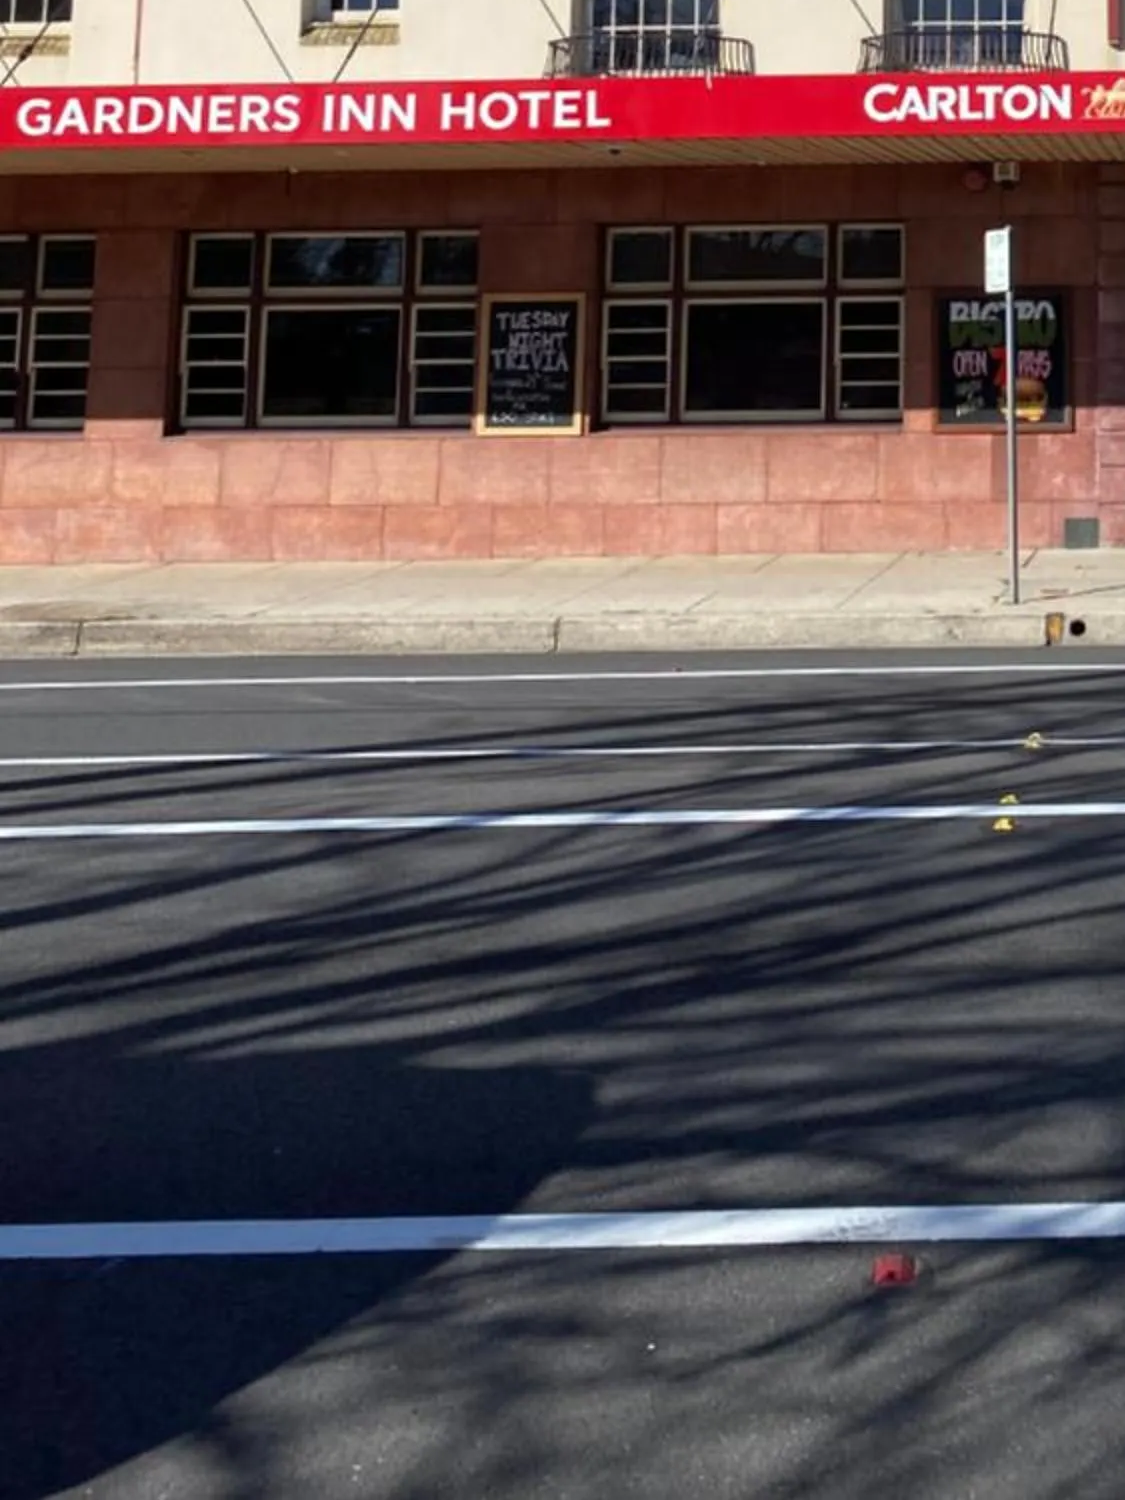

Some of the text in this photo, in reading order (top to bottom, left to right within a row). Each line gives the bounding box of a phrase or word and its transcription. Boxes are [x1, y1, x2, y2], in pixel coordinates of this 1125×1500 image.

[15, 89, 611, 137] GARDNERS INN HOTEL
[862, 83, 1072, 122] CARLTON
[496, 311, 571, 330] TUESDAY
[949, 300, 1057, 350] BISRO
[508, 332, 569, 351] NIGHT
[491, 348, 569, 373] TRIVIA
[953, 350, 988, 378] OPEN
